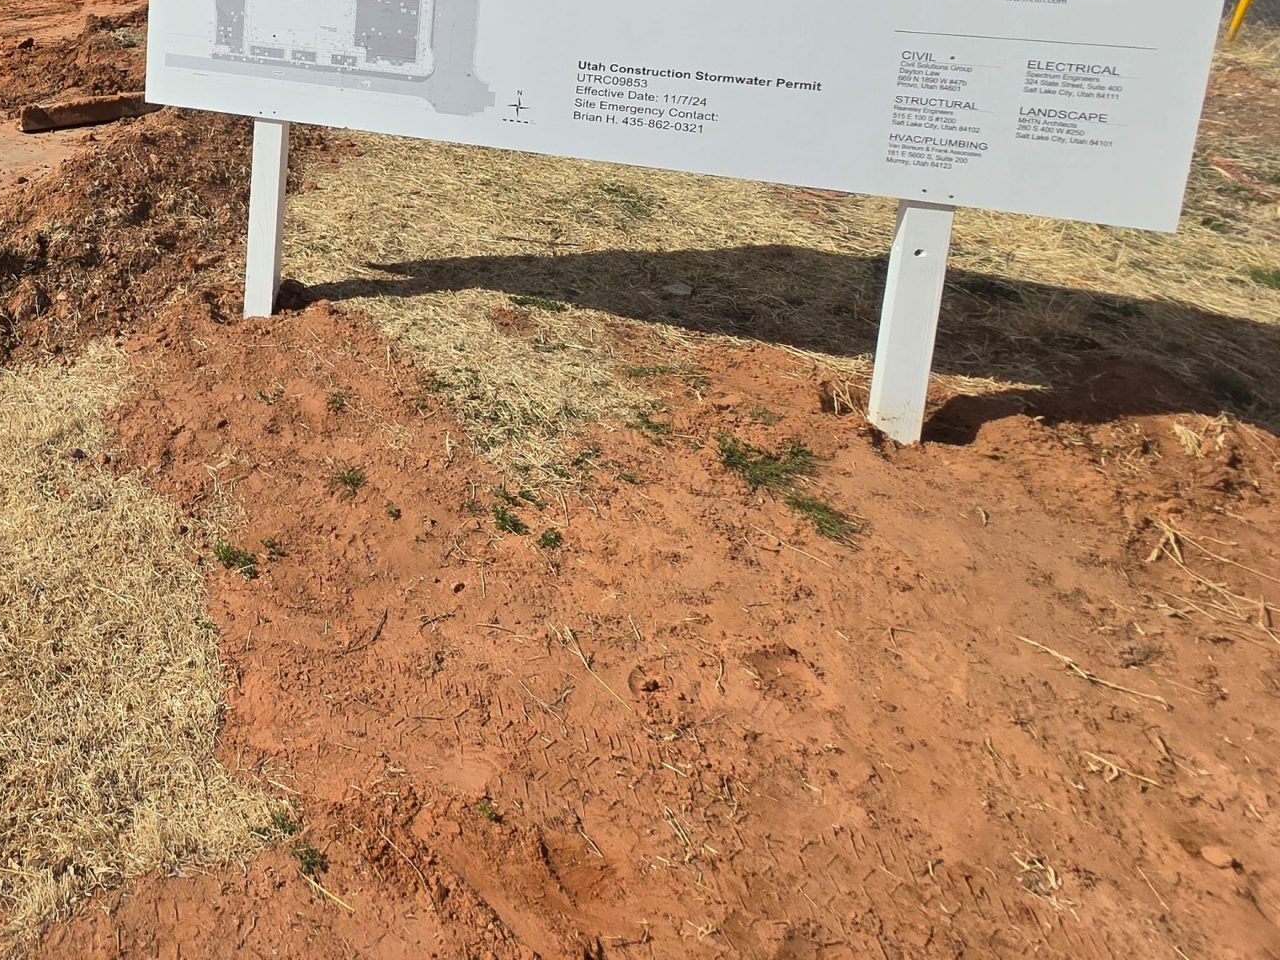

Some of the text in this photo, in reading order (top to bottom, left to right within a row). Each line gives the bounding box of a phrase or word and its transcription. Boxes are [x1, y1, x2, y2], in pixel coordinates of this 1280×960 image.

[901, 51, 936, 61] CIVIL
[899, 67, 923, 75] Dayton
[917, 62, 948, 70] Solutions
[1027, 60, 1120, 76] ELECTRICAL
[577, 73, 648, 88] UTRC09853
[578, 61, 822, 91] Utah Construction Stormwater Permit
[1026, 71, 1100, 82] Spectrum Engineers
[576, 86, 707, 106] Effective Date: 11/7/24
[1058, 89, 1075, 97] City,
[895, 95, 978, 110] STRUCTURAL
[574, 99, 719, 122] Site Emergency Contact:
[1019, 107, 1108, 123] LANDSCAPE
[573, 111, 704, 133] Brian H. 435-862-0321
[924, 122, 939, 130] City,
[1018, 117, 1077, 128] MHTN Architects
[889, 133, 988, 150] HVAC/PLUMBING
[1051, 136, 1067, 144] City,
[886, 157, 911, 166] Murray,
